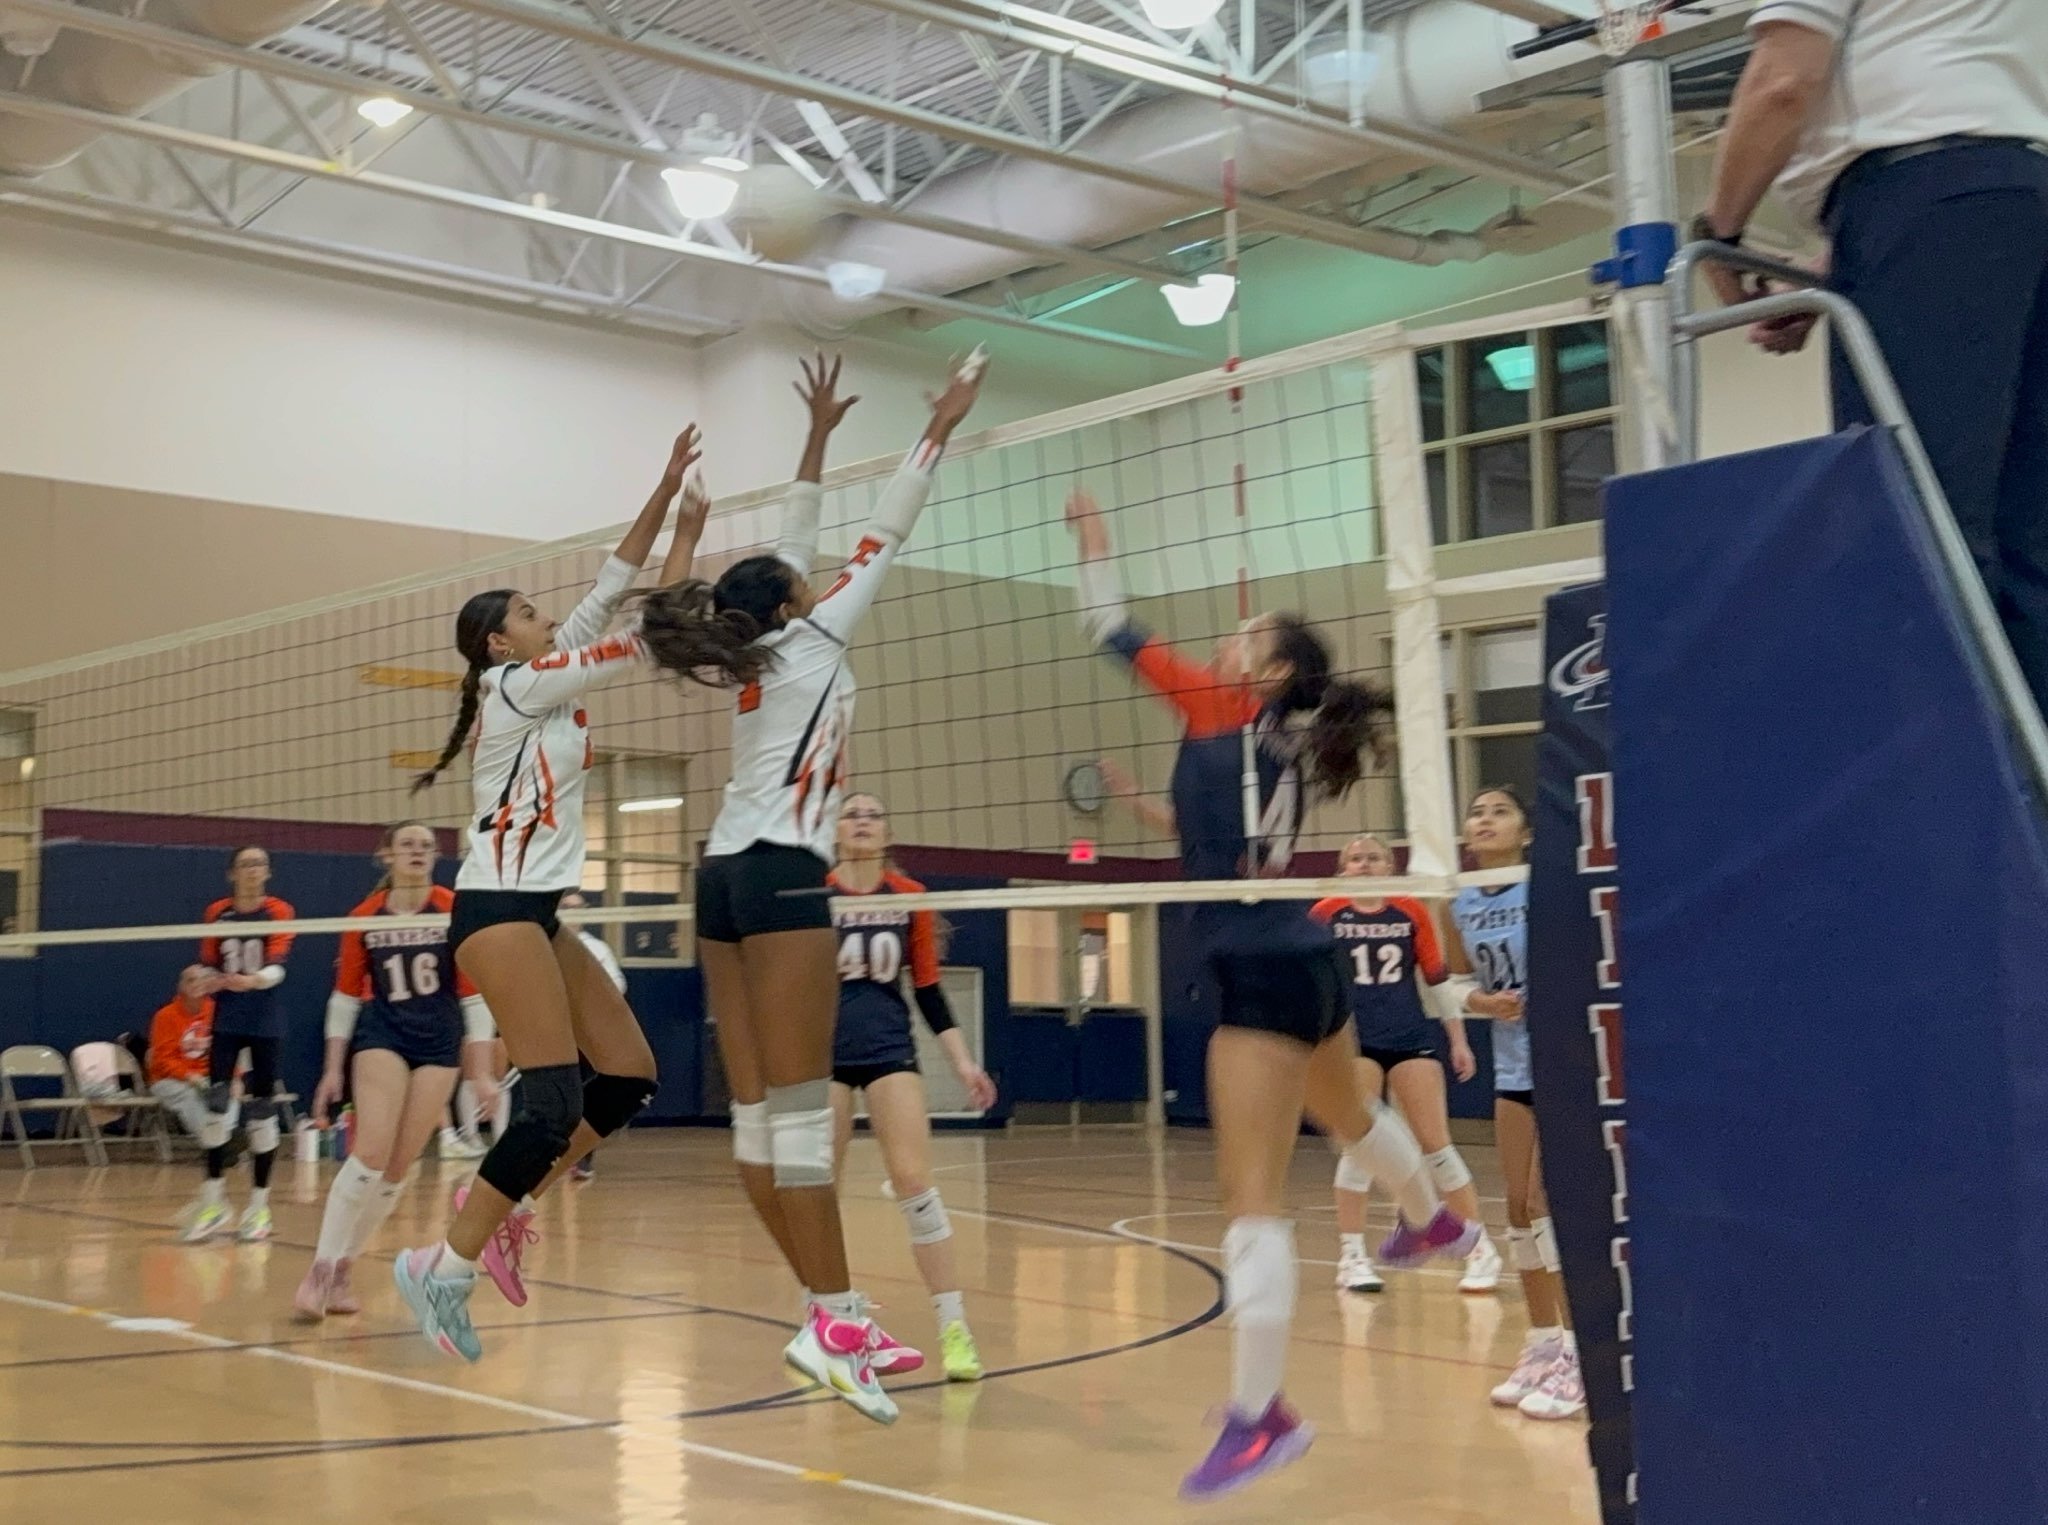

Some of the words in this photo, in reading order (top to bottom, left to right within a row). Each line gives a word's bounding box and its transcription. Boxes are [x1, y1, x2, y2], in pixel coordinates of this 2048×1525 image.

[383, 952, 440, 1002] 16
[837, 931, 901, 983] 40
[1350, 943, 1403, 985] 12
